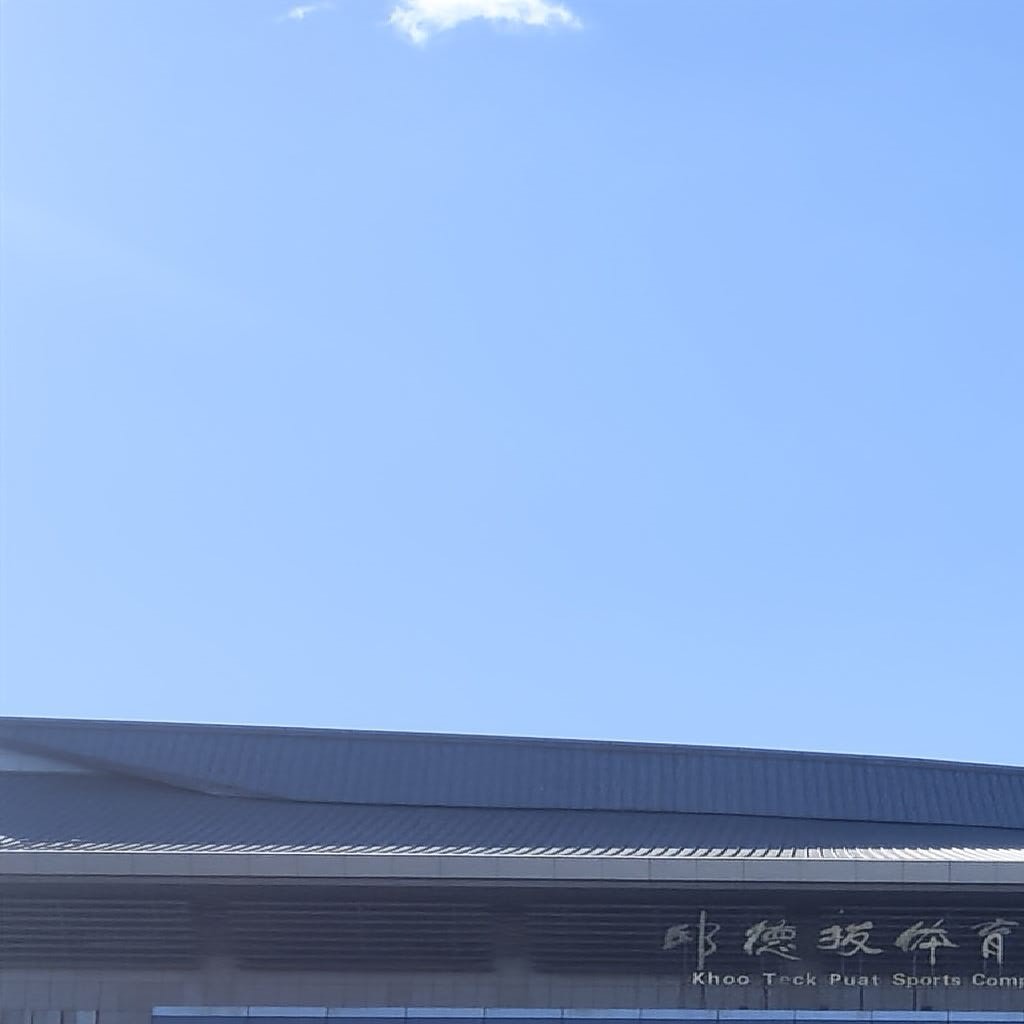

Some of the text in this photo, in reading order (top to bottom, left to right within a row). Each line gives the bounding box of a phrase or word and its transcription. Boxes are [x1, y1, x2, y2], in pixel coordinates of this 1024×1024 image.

[692, 972, 749, 985] Khoo
[763, 972, 816, 985] Teck
[830, 973, 880, 986] Puat
[892, 973, 961, 988] Sports
